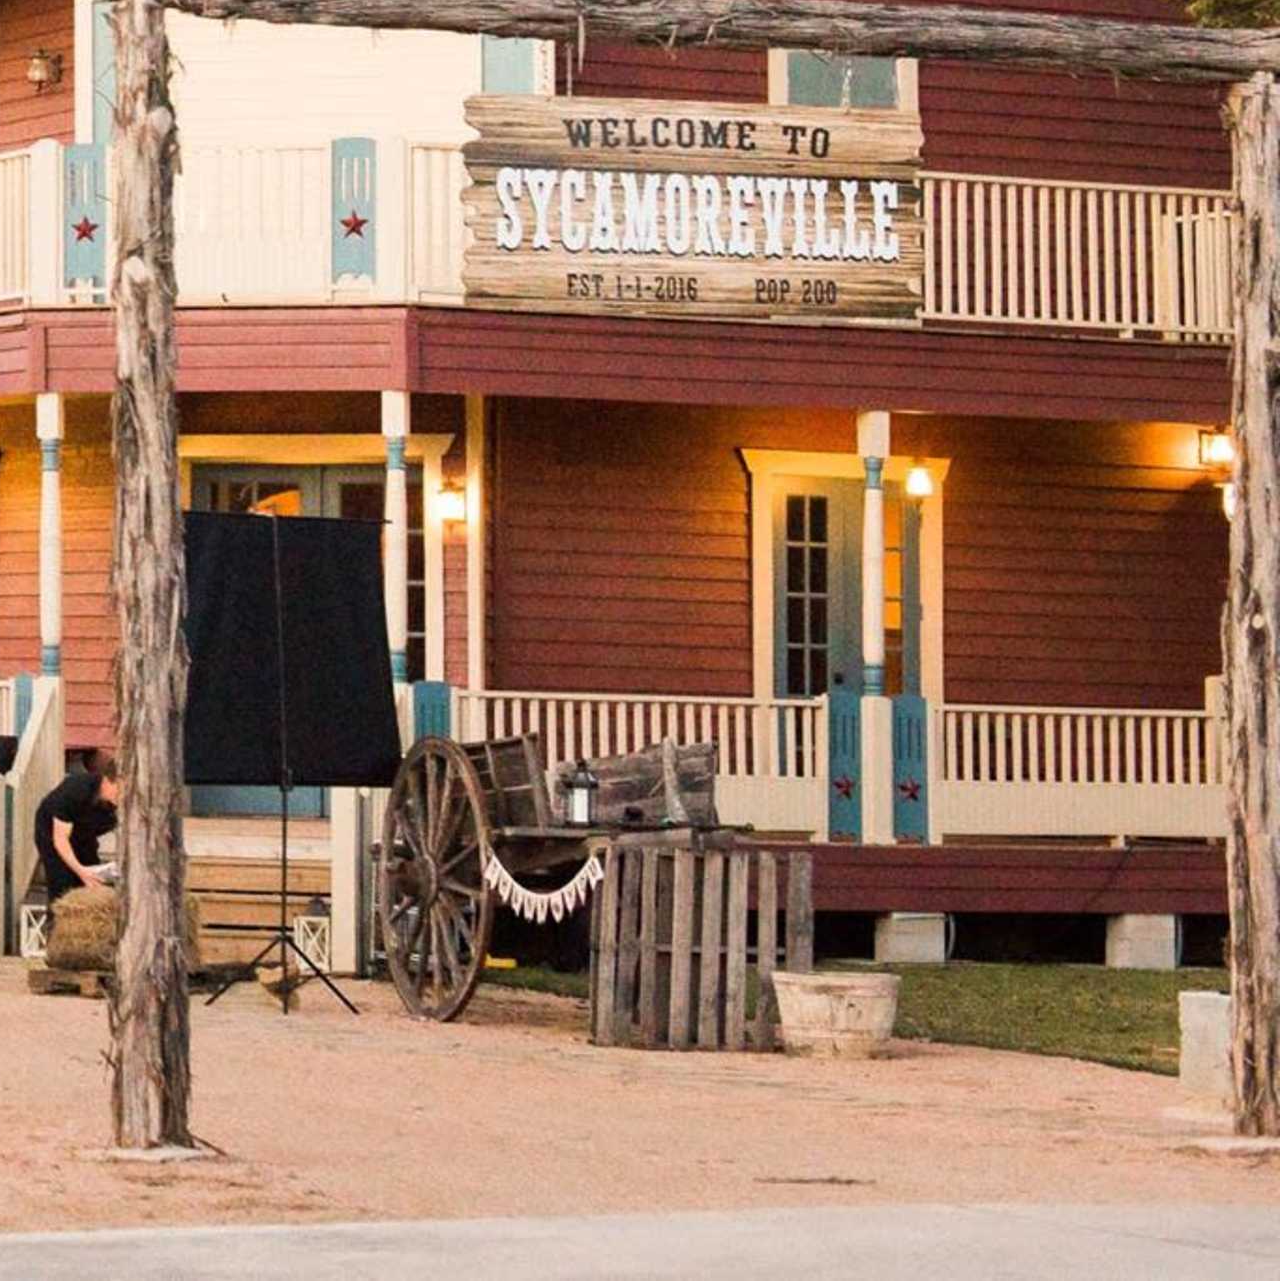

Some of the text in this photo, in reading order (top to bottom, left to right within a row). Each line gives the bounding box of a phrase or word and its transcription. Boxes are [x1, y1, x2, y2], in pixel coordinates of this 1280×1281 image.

[562, 117, 831, 158] WELCOME TO
[495, 167, 901, 263] SYCAMOREVILLE
[616, 275, 699, 301] 1-1-2016
[801, 279, 838, 305] 200
